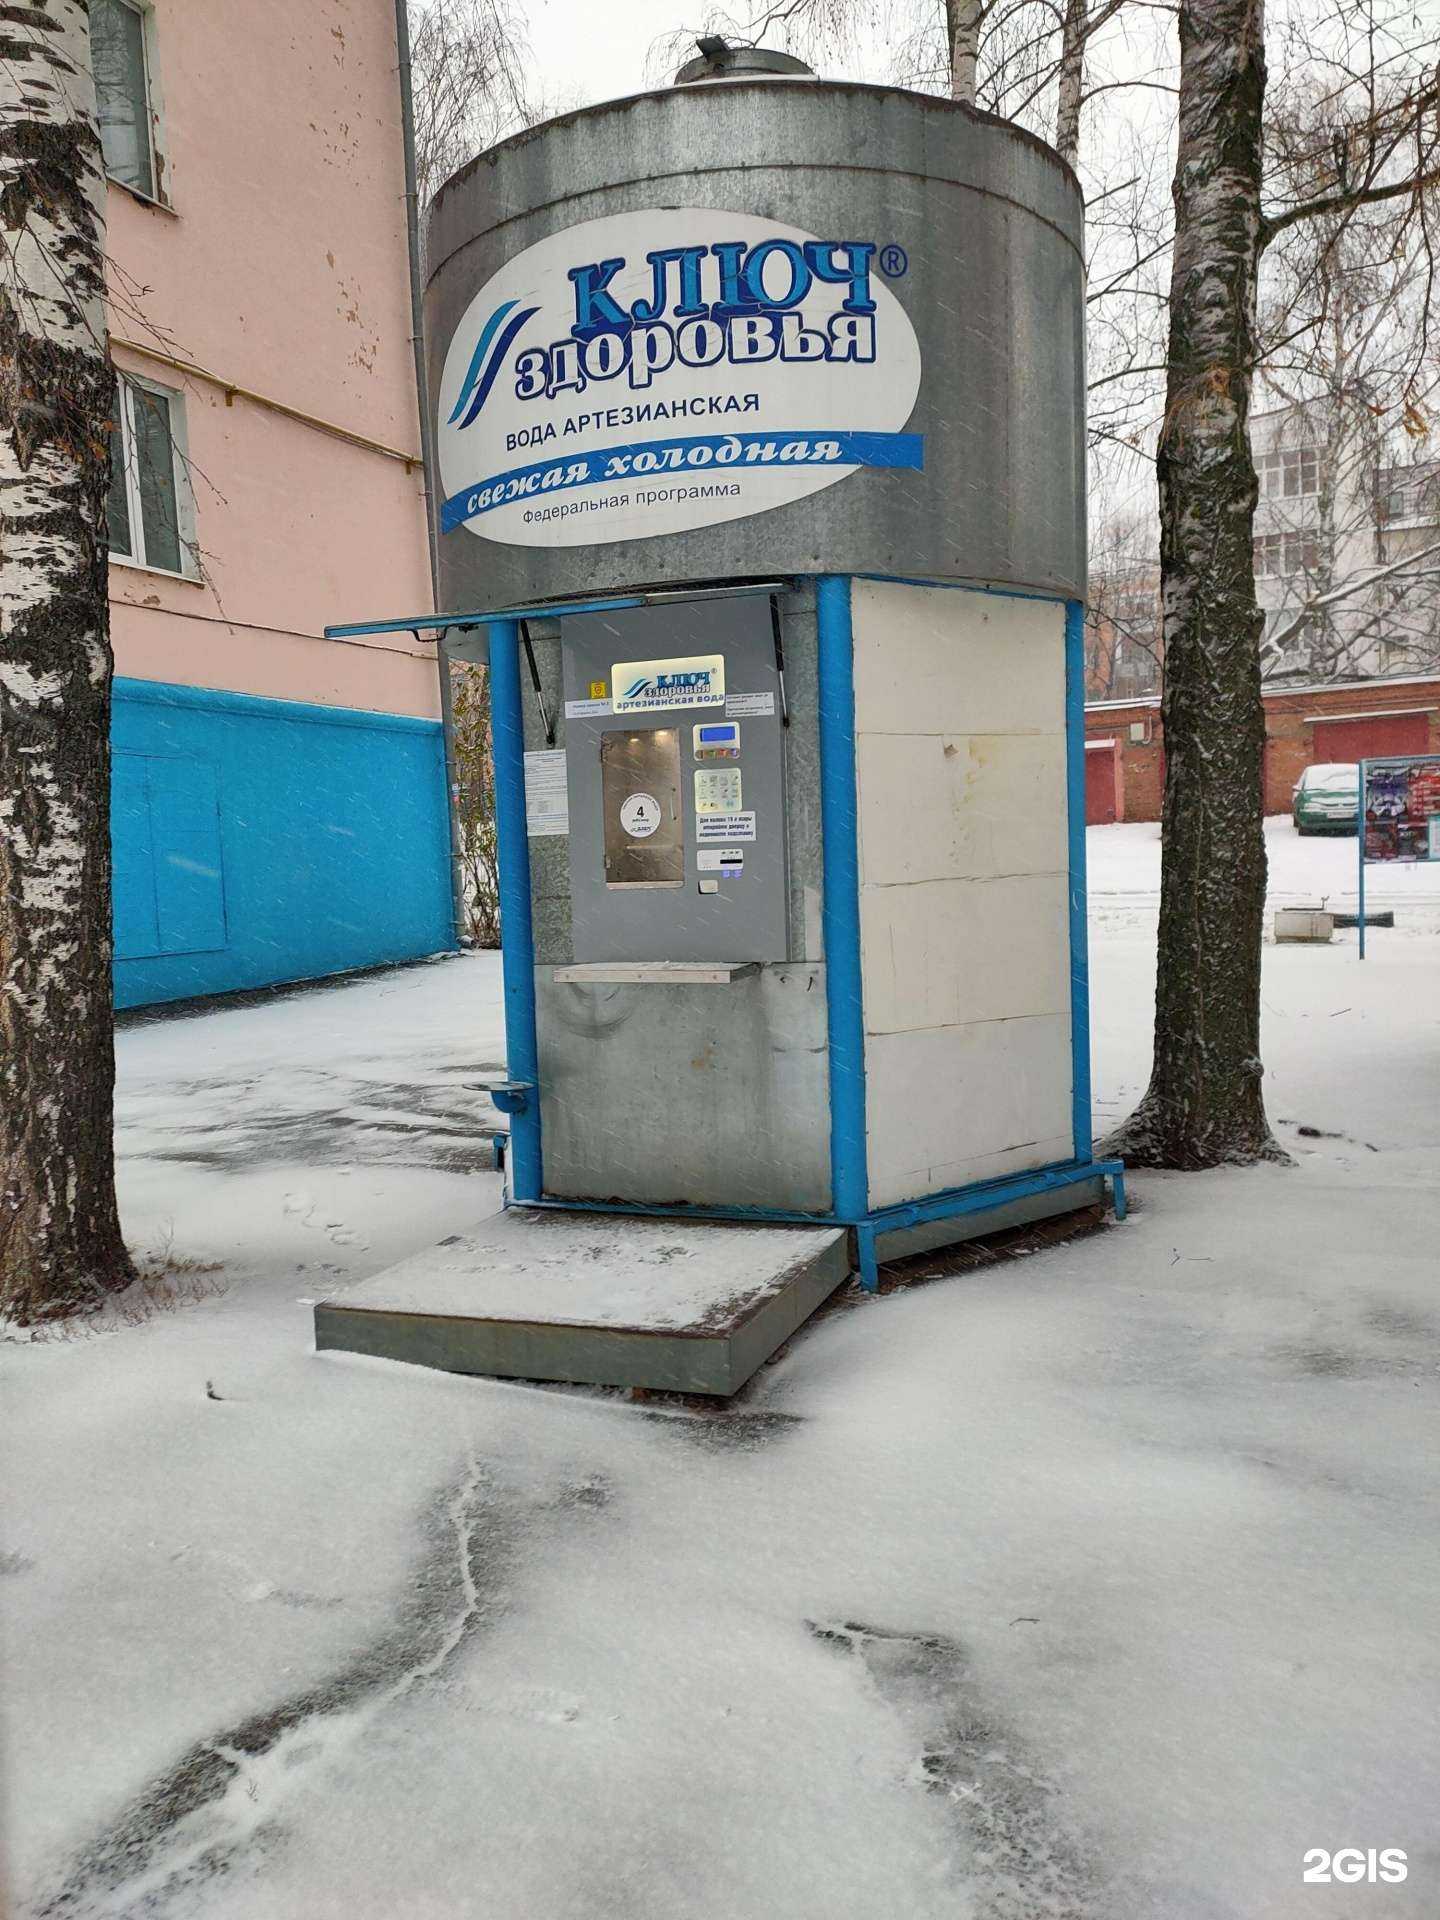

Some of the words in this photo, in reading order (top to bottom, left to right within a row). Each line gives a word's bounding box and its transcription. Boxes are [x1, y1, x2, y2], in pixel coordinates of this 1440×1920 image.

[567, 239, 877, 333] КЛЮЧ
[514, 311, 877, 400] здоровья
[506, 421, 557, 451] ВОДА
[563, 393, 760, 435] АРТЕЗИАНСКАЯ
[467, 462, 591, 514] свежая
[603, 435, 843, 478] холодная
[523, 494, 629, 525] Федеральная
[636, 483, 741, 508] программа
[616, 696, 694, 711] артезианская
[696, 694, 724, 704] вода
[656, 671, 711, 688] КЛЮЧ
[636, 805, 645, 818] 4
